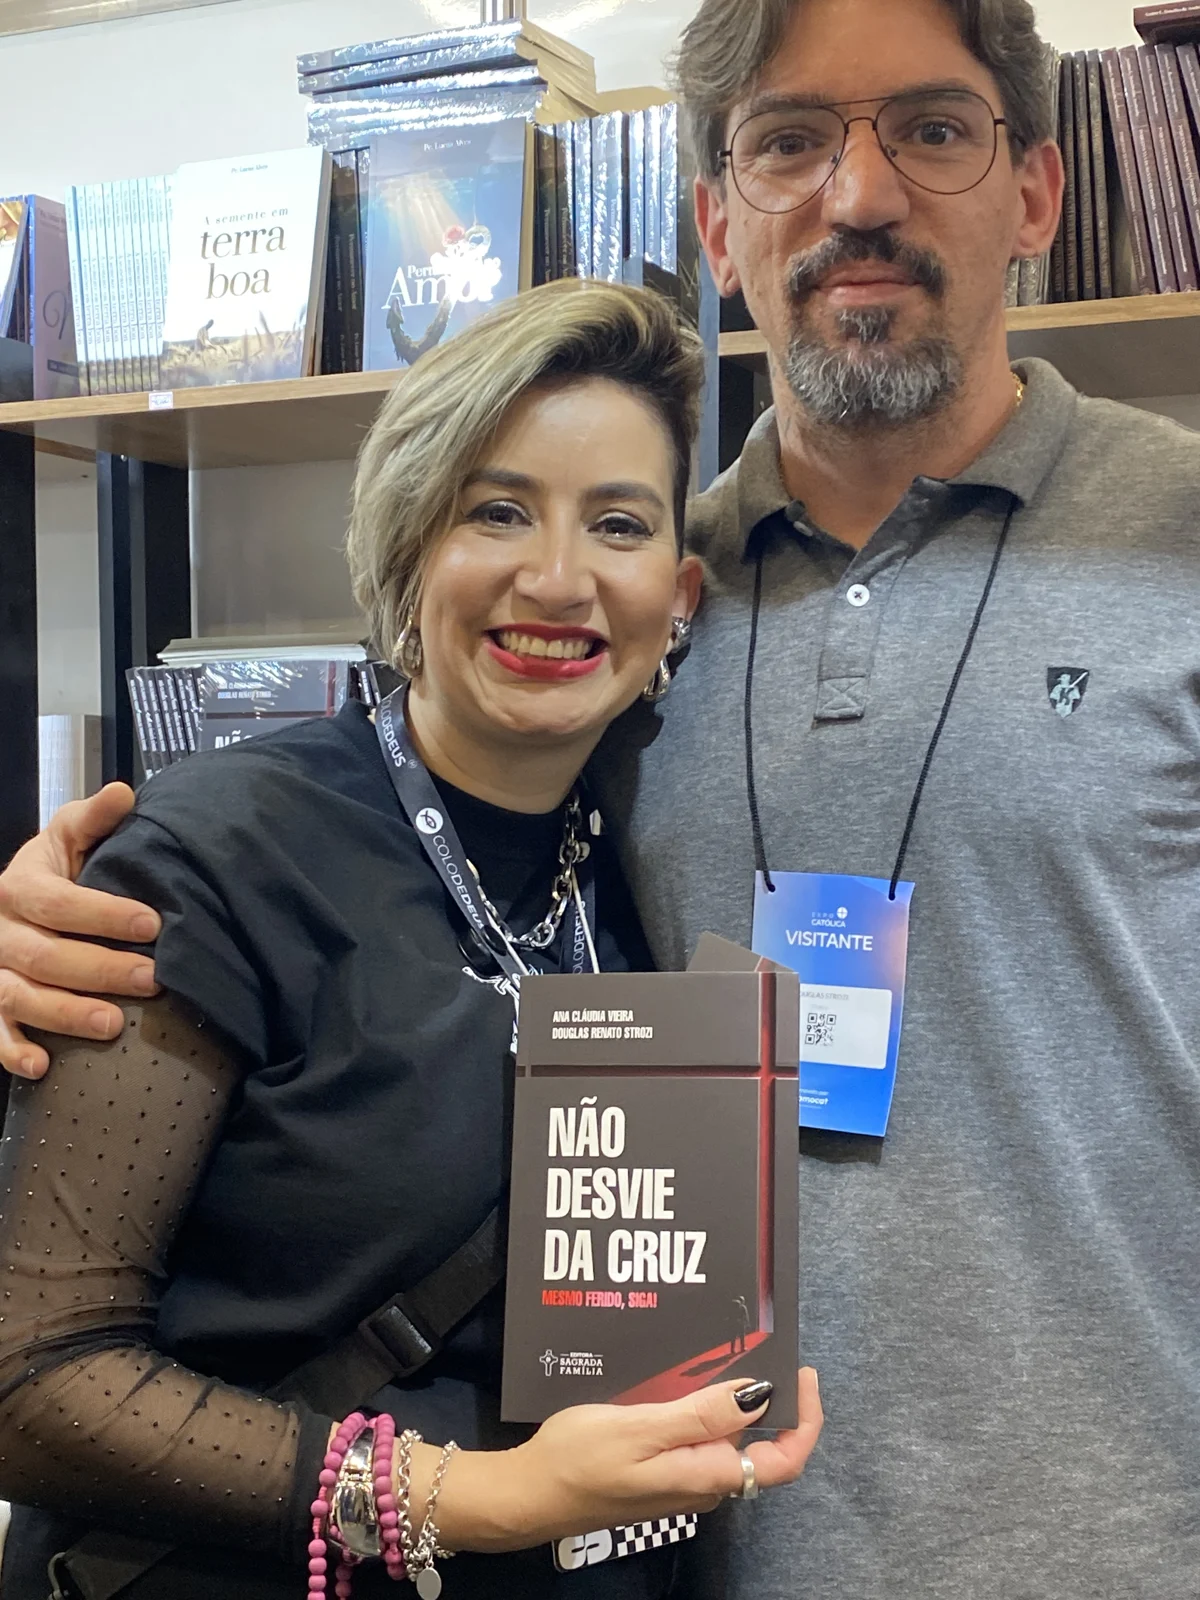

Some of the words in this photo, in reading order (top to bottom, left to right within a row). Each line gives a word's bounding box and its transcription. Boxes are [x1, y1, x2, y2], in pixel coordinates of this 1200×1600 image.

[204, 216, 210, 225] A
[216, 211, 266, 224] semente
[272, 208, 288, 218] em
[200, 226, 288, 260] terra
[205, 262, 272, 300] boa
[214, 730, 252, 749] NÃ
[381, 696, 406, 768] OLODEDEUS
[812, 918, 846, 928] CATÓLICA
[786, 930, 874, 951] VISITANTE
[552, 1010, 570, 1022] ANA
[572, 1008, 606, 1022] CLÁUDIA
[608, 1010, 634, 1022] VIEIRA
[552, 1027, 590, 1039] DOUGLAS
[591, 1026, 622, 1039] RENATO
[624, 1026, 654, 1039] STROZI
[548, 1096, 626, 1158] NÃO
[546, 1167, 675, 1220] DESVIE
[544, 1229, 594, 1281] DA
[608, 1228, 707, 1284] CRUZ
[542, 1290, 583, 1306] MESMO
[585, 1291, 625, 1310] FERIDO,
[628, 1292, 658, 1308] SIGA!
[560, 1358, 603, 1367] SAGRADA
[560, 1366, 603, 1376] FAMÍLIA
